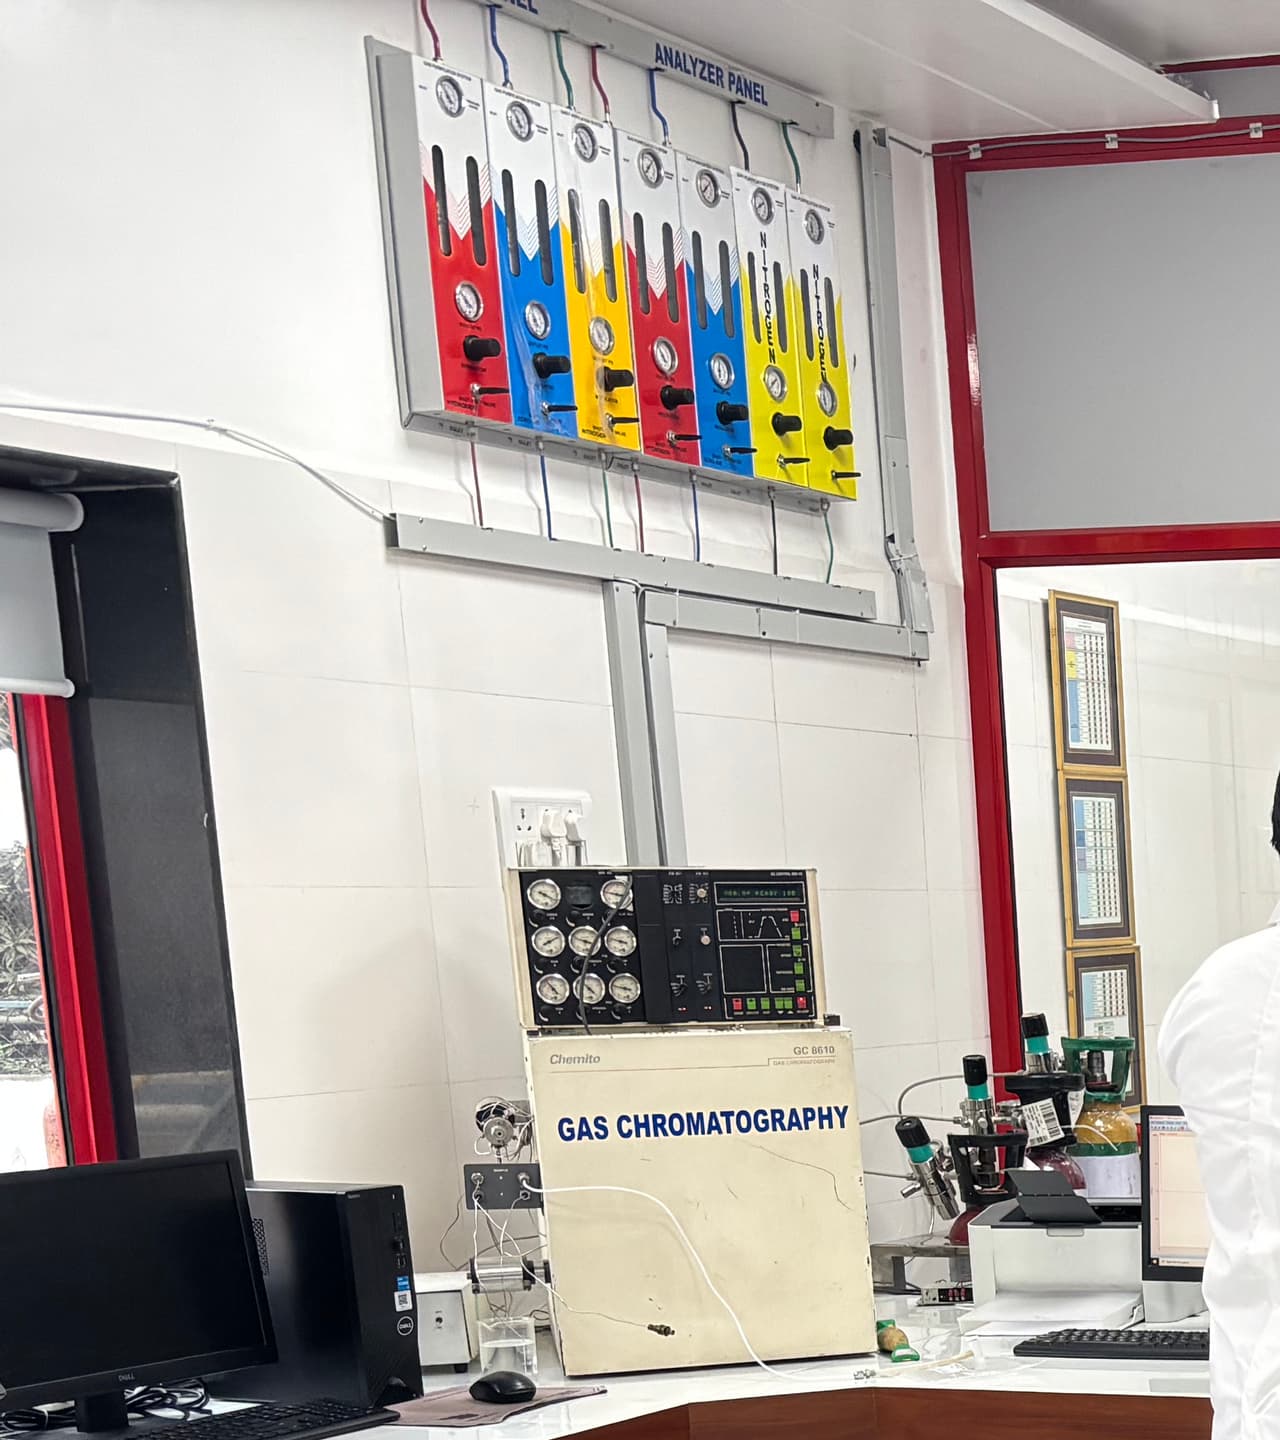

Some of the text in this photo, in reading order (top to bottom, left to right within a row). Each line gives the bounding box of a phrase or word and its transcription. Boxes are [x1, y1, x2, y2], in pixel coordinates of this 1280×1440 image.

[656, 42, 768, 106] ANALYZER PANEL
[793, 1046, 809, 1055] GC
[557, 1105, 849, 1142] GAS CHROMATOGRAPHY
